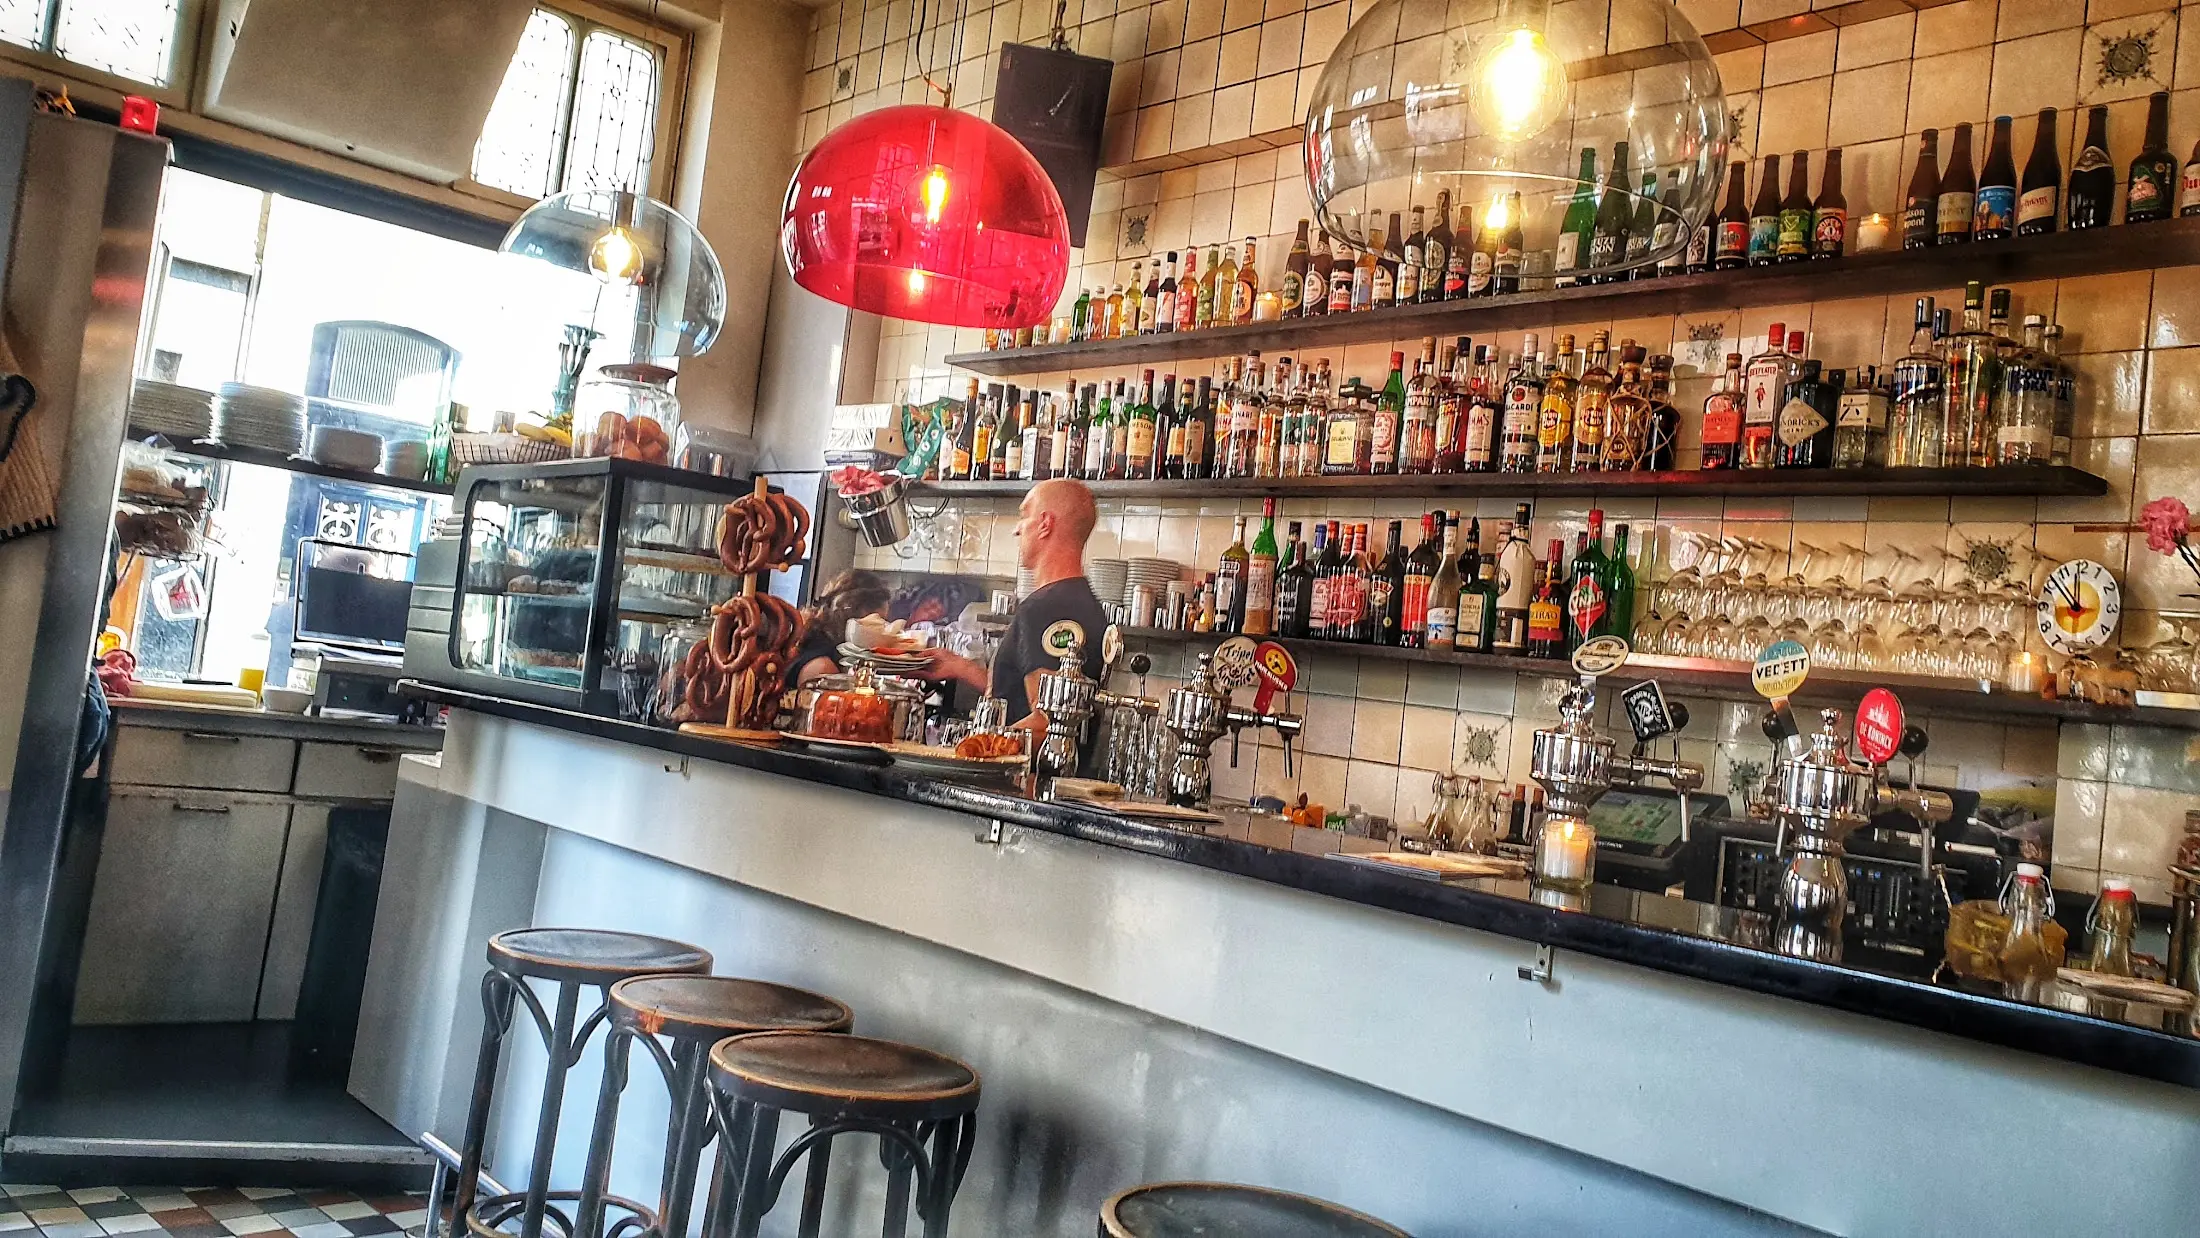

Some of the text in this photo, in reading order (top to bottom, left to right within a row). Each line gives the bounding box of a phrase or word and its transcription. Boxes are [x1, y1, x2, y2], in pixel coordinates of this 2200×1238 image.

[1749, 366, 1777, 377] BEEFEATER
[2059, 565, 2070, 580] 11
[2076, 560, 2089, 574] 12
[2094, 566, 2103, 579] 1
[2103, 581, 2116, 595] 2
[2106, 603, 2119, 614] 3
[2040, 620, 2052, 634] 8
[2100, 623, 2111, 636] 4
[2051, 633, 2062, 647] 7
[1223, 643, 1256, 660] Tripel
